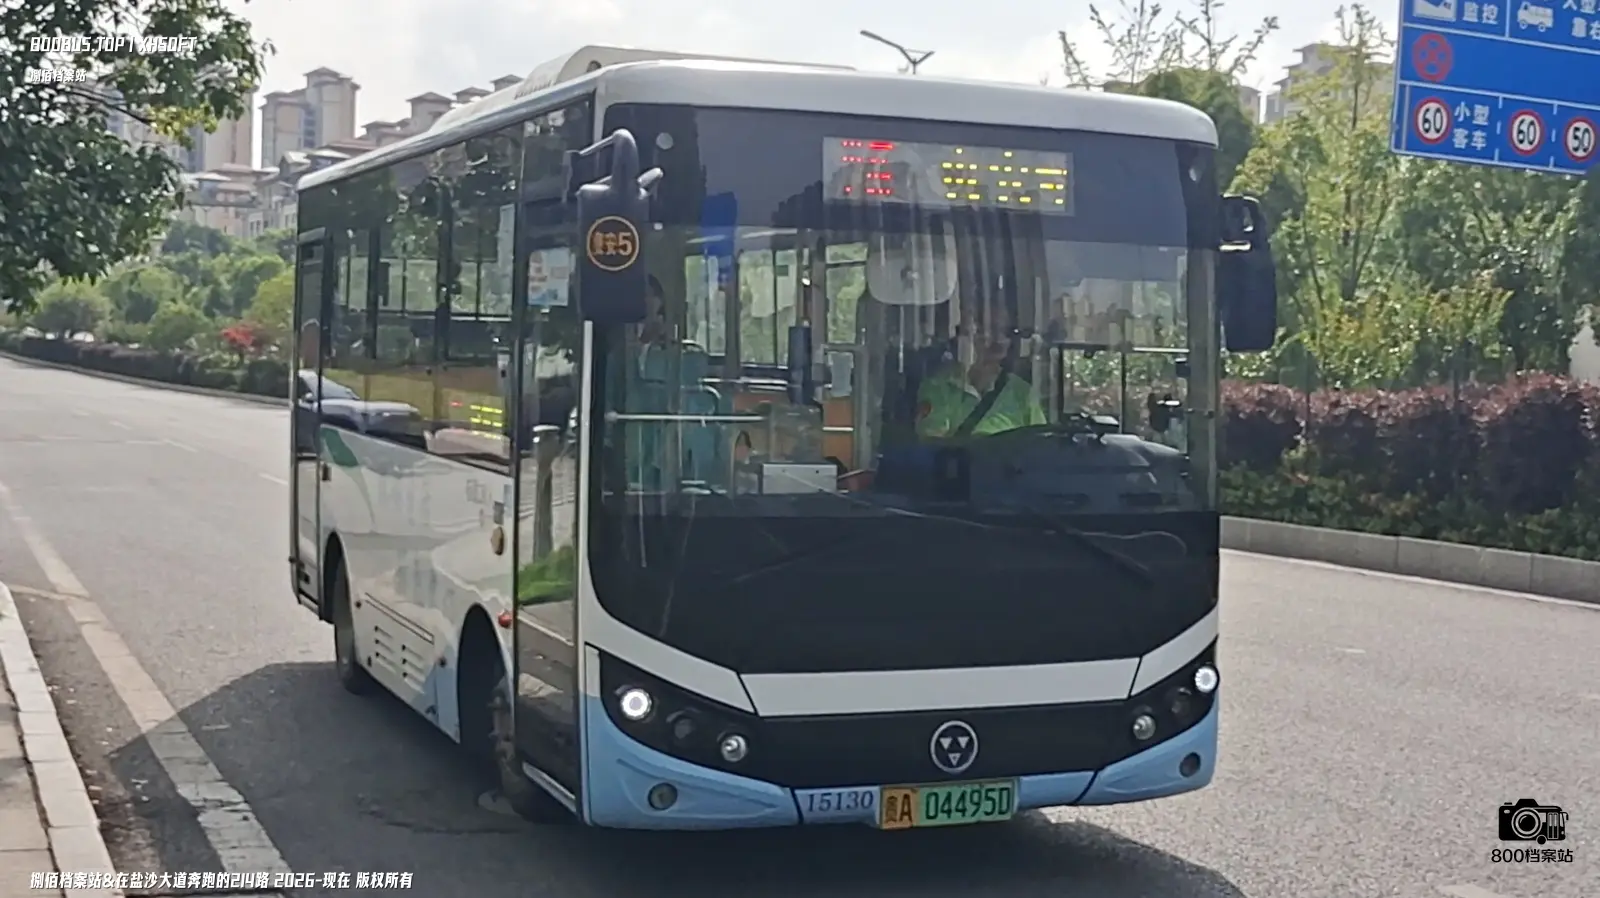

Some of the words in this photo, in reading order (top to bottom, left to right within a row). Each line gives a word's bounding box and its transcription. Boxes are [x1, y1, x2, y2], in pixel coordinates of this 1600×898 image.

[1422, 107, 1443, 134] 60
[1454, 101, 1490, 125] 小型
[1452, 127, 1487, 150] 客车
[1517, 118, 1537, 146] 60
[1572, 126, 1591, 153] 50
[807, 790, 874, 813] 15130
